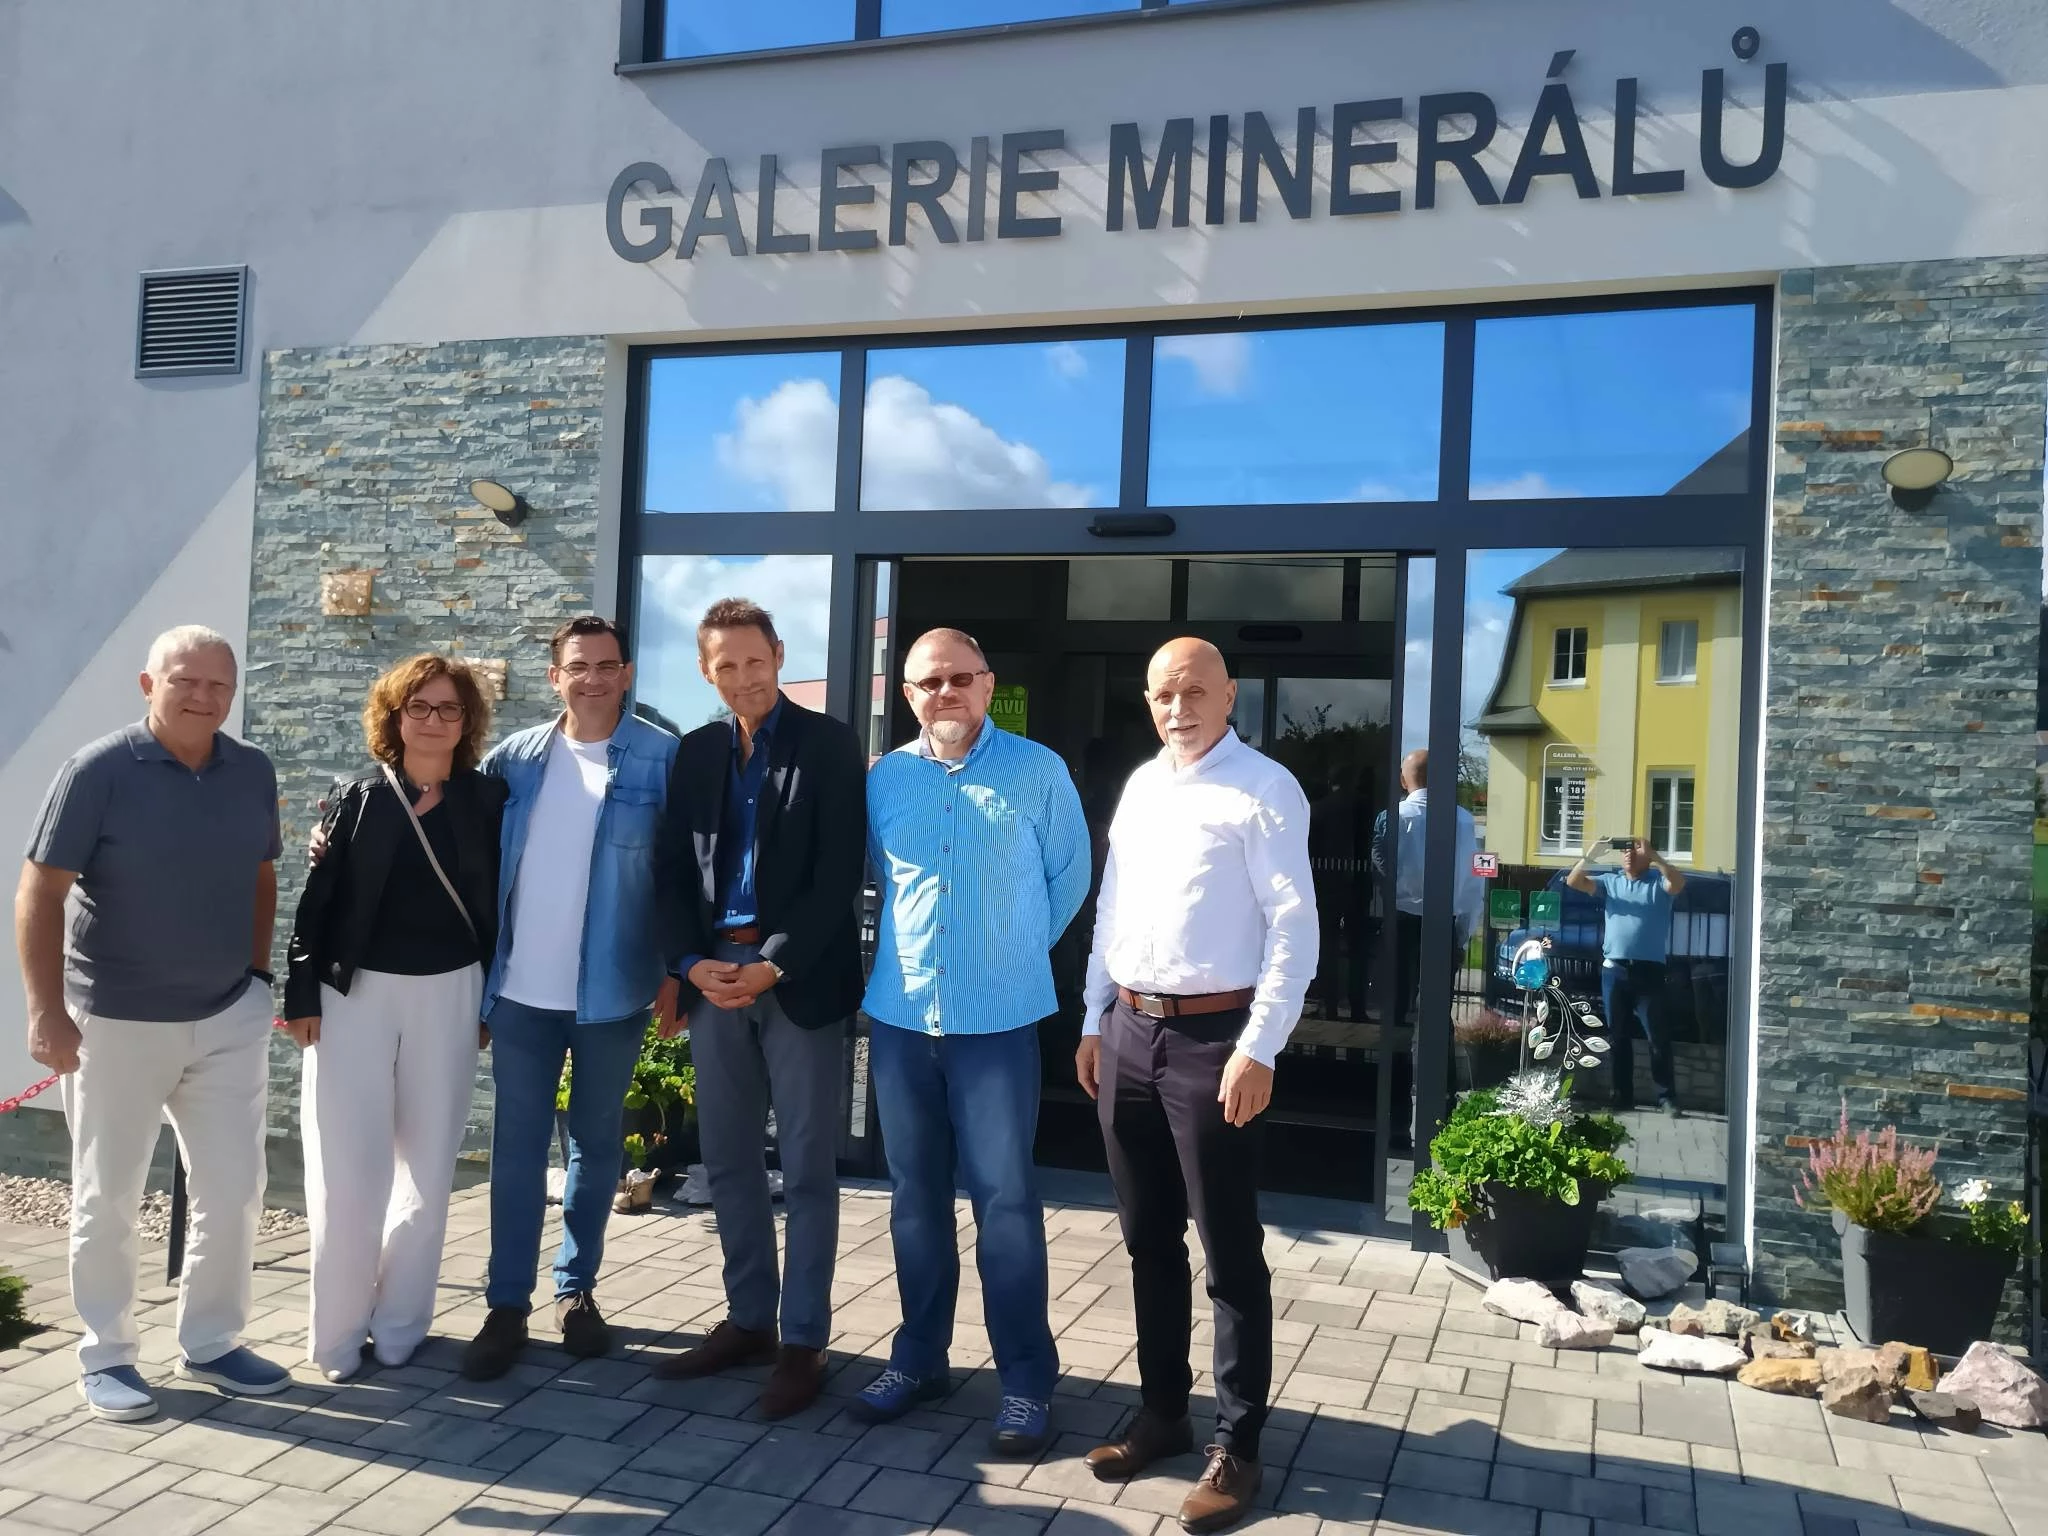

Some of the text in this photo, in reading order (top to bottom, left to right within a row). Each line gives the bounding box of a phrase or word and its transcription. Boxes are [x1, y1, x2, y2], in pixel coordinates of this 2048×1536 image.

[605, 26, 1788, 264] GALERIE MINERÁLŮ
[1554, 786, 1565, 794] 10
